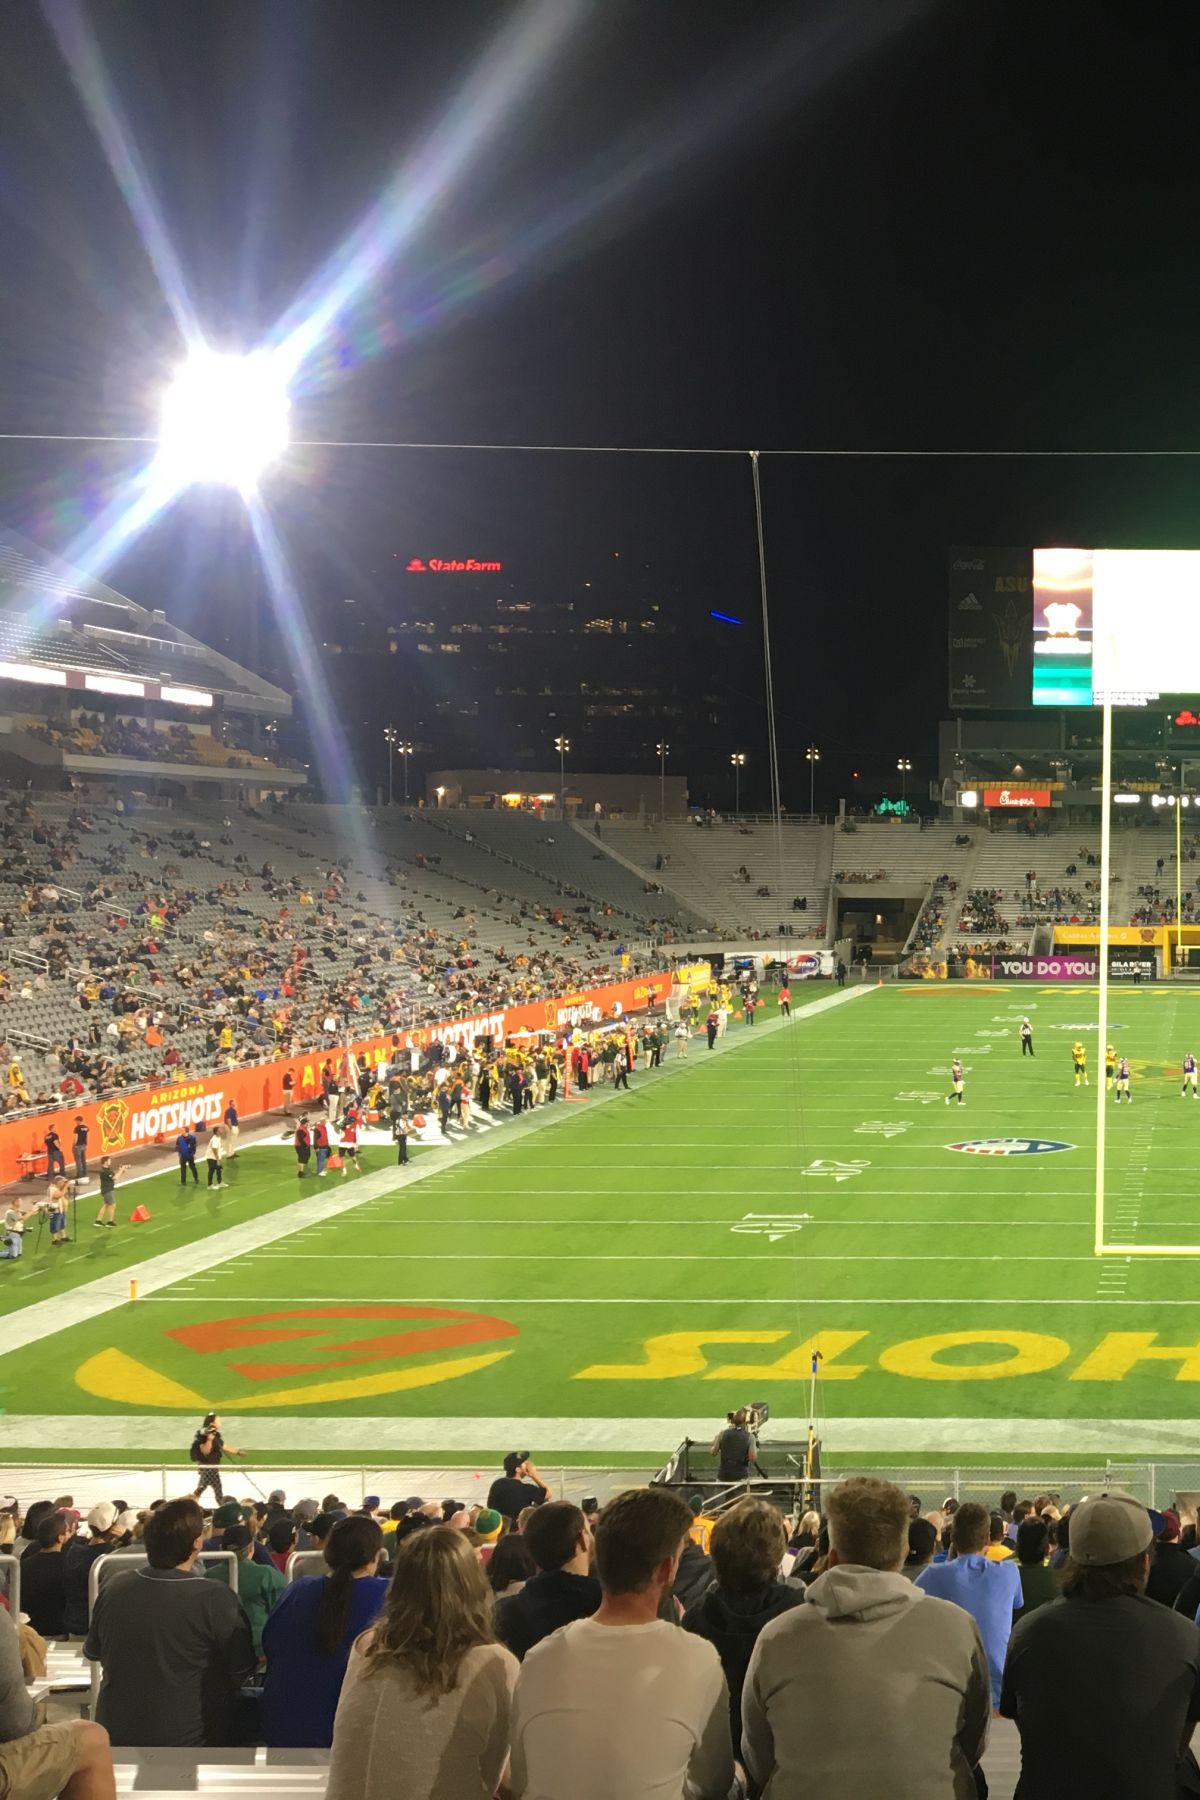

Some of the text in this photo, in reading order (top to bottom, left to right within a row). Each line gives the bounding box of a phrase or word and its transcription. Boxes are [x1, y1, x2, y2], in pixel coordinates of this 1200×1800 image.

[1001, 961, 1096, 976] YOU DO YOU
[151, 1084, 205, 1105] ARIZONA
[131, 1092, 224, 1141] HOTSHOTS
[730, 1213, 815, 1233] 10
